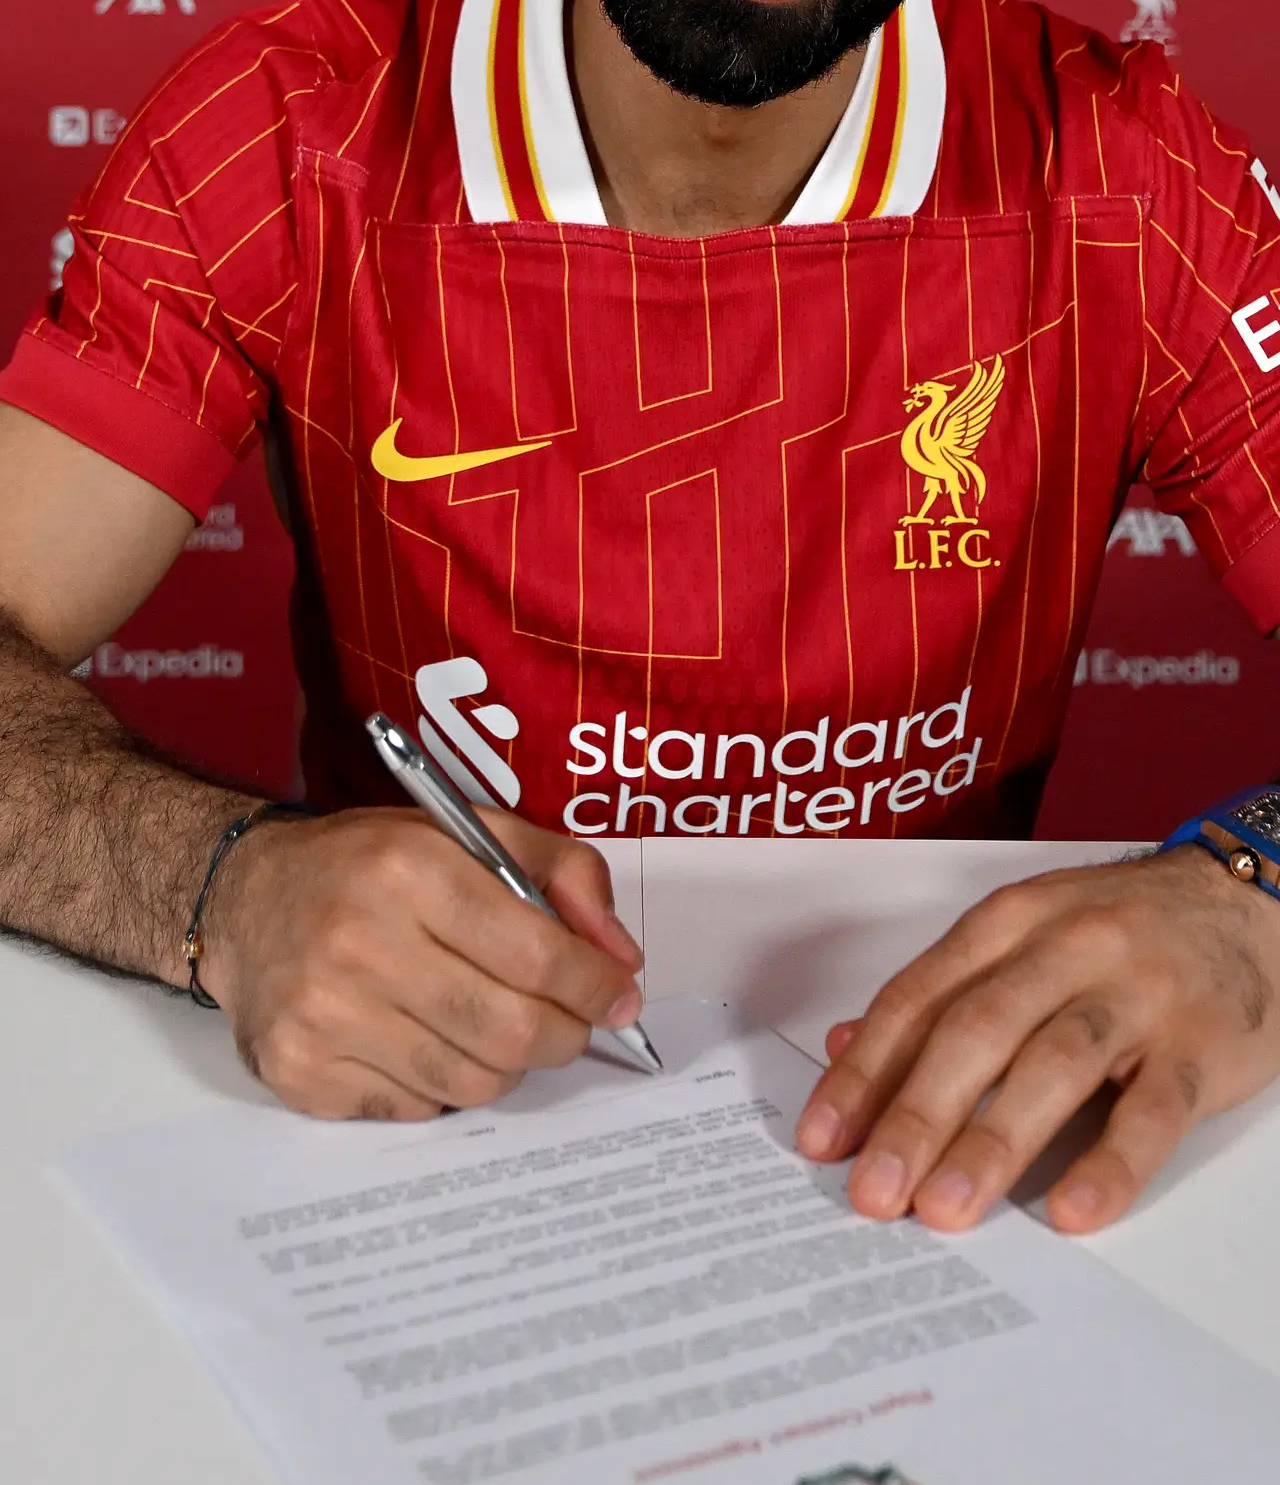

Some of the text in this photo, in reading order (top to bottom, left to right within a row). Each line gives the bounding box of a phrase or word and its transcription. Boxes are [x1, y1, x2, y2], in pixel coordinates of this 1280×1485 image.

[893, 528, 1001, 571] L.F.C.
[1091, 647, 1240, 688] Expedia
[565, 684, 972, 780] standard
[562, 737, 983, 835] chartered
